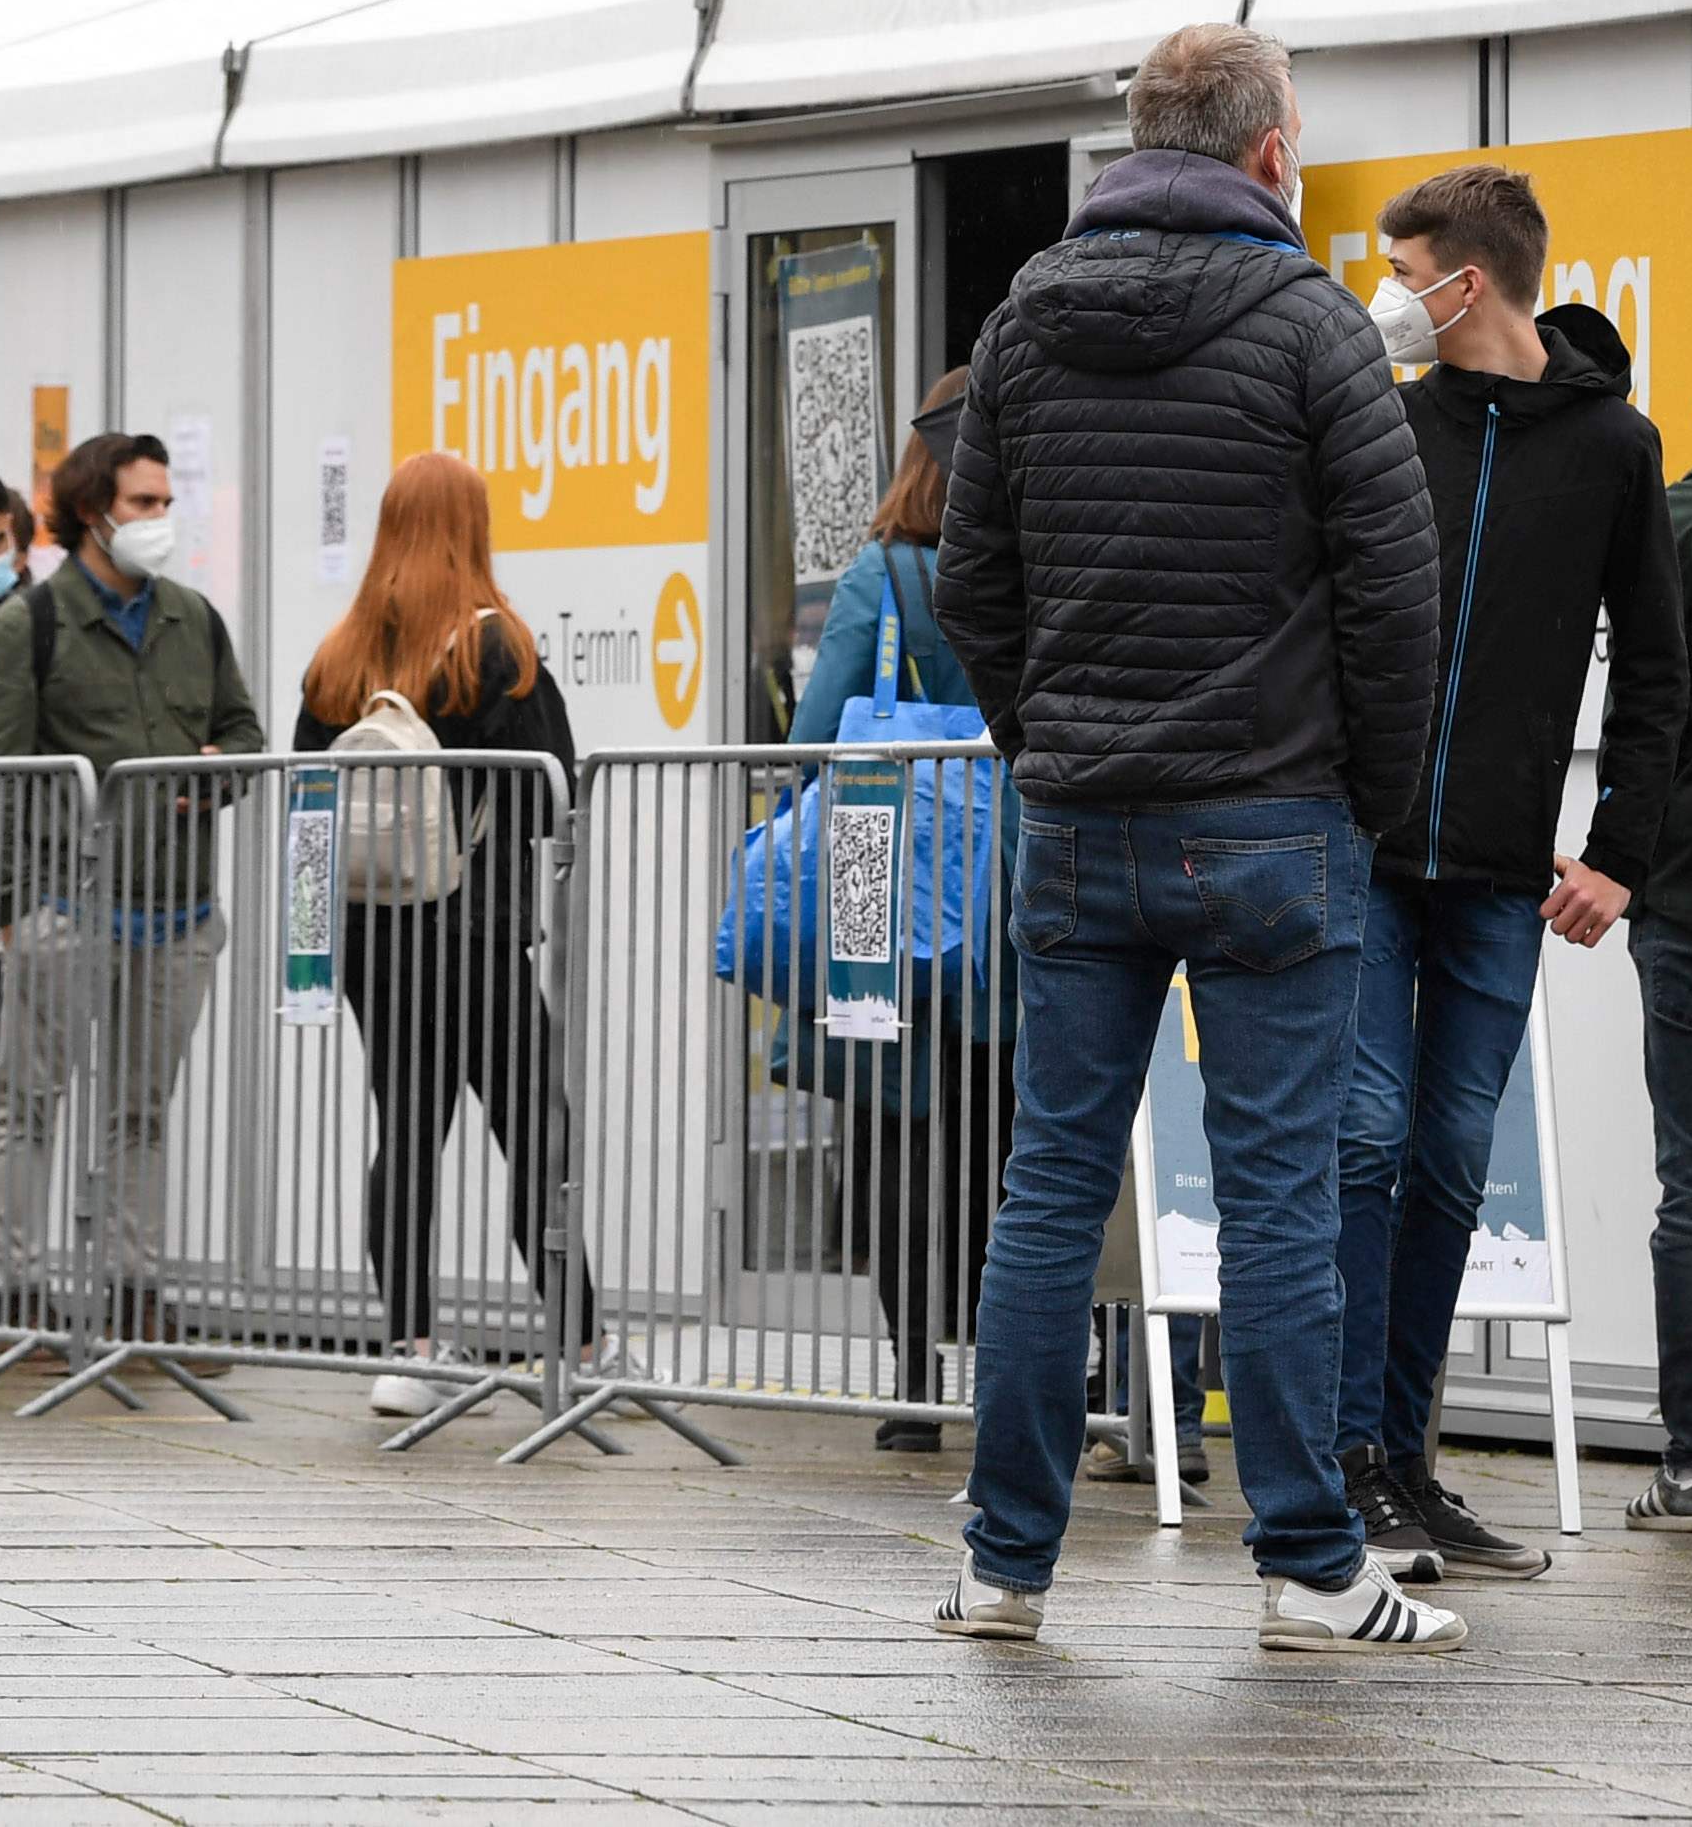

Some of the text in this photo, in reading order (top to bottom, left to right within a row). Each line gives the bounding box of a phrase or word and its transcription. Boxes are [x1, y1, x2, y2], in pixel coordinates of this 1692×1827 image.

[432, 301, 671, 521] Eingang
[560, 608, 641, 687] Termin
[1175, 1173, 1208, 1188] Bitte
